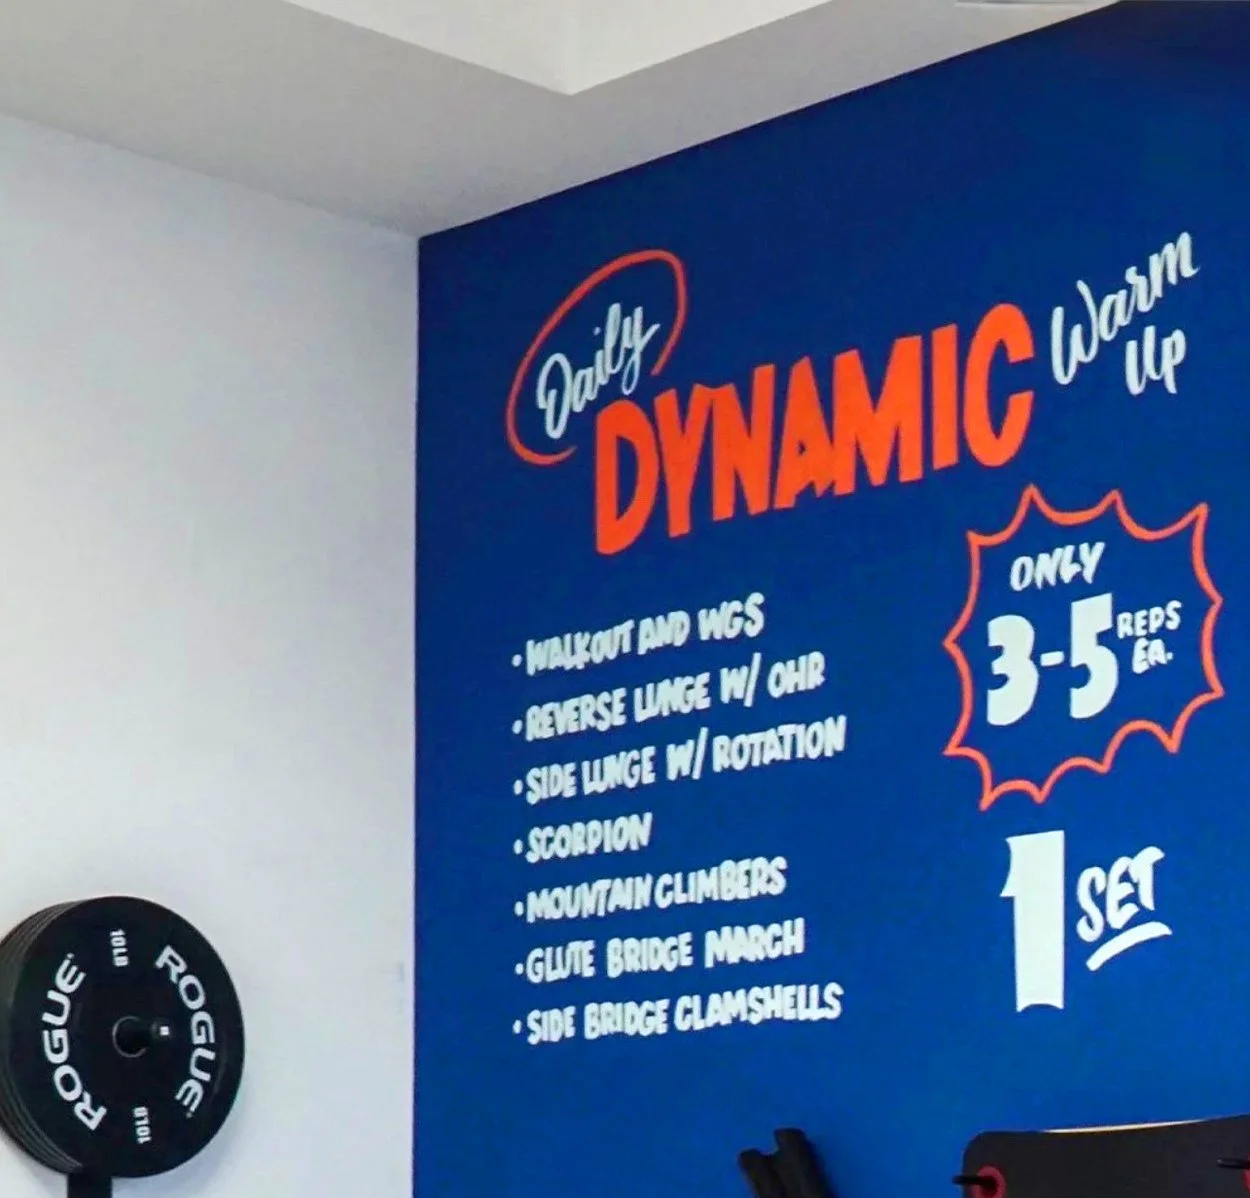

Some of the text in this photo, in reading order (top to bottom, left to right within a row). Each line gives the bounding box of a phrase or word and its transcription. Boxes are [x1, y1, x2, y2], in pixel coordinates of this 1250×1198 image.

[1052, 233, 1196, 385] Warm
[536, 302, 660, 439] Daily
[1126, 329, 1186, 395] Up
[596, 304, 1034, 554] DYNAMIC
[1010, 542, 1105, 591] ONLY
[526, 592, 764, 676] WALKOUT AND WGS
[987, 592, 1182, 726] 3-5 REPS
[526, 651, 826, 741] REVERSE LUNGE W/ OHR
[526, 715, 847, 804] SIDE LUNGE W/ ROTATION
[526, 812, 652, 863] SCORPION
[526, 856, 788, 923] MOUNTAIN CLIMBERS
[1000, 829, 1165, 1012] 1 SET
[526, 917, 805, 983] GLUTE BRIDGE MARCH
[41, 952, 107, 1130] ROGUE
[155, 945, 216, 1119] ROGUE
[527, 981, 844, 1044] SIDE BRIDGE CLAMSHELLS
